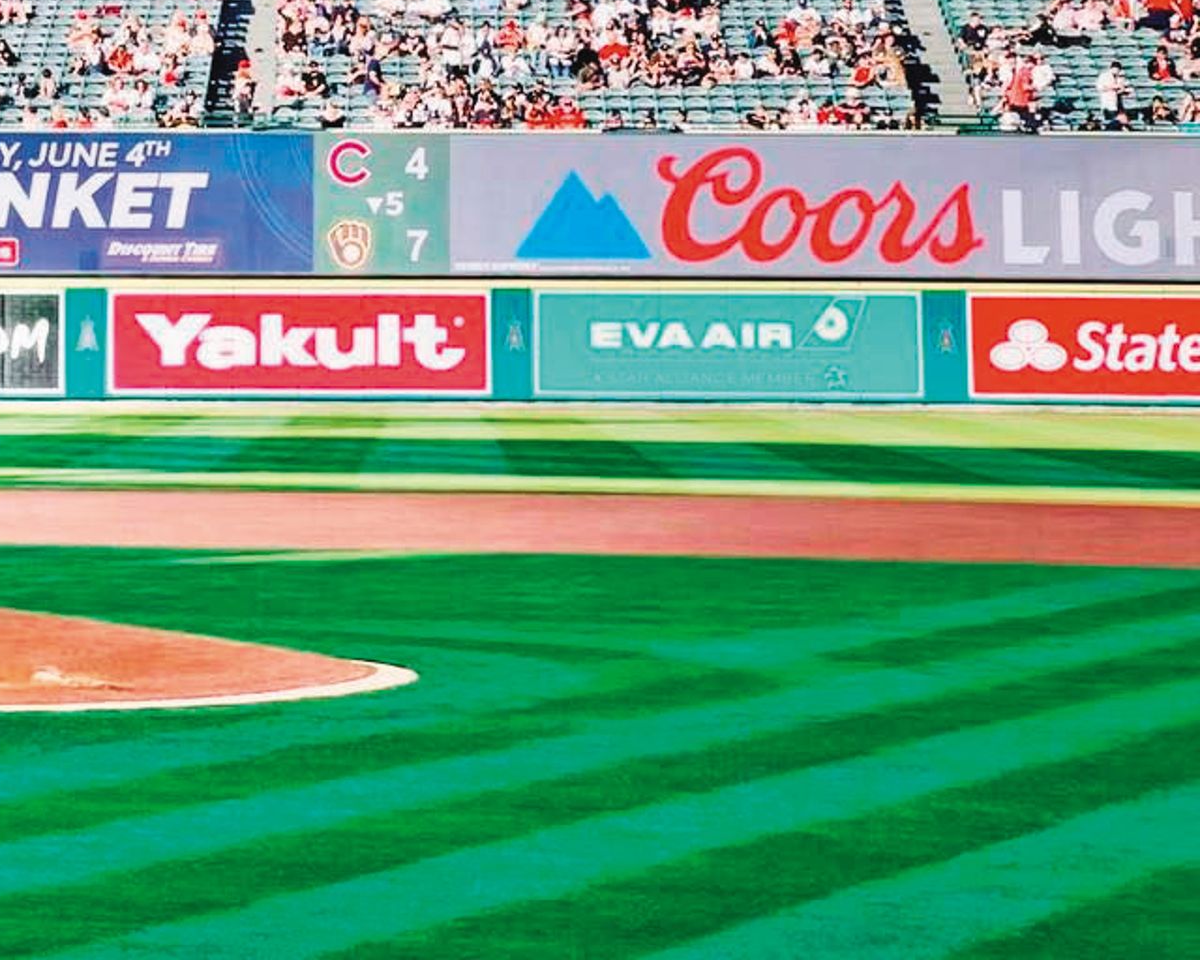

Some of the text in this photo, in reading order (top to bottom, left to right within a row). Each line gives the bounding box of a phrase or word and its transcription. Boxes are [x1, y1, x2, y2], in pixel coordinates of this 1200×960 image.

[28, 141, 120, 169] JUNE
[124, 139, 172, 169] 4TH
[327, 138, 372, 187] C
[404, 146, 429, 181] 4
[385, 191, 405, 217] 5
[657, 147, 985, 264] Coors
[406, 228, 430, 263] 7
[134, 312, 466, 371] Yakult
[590, 321, 793, 349] EVA AIR
[1072, 320, 1200, 373] State
